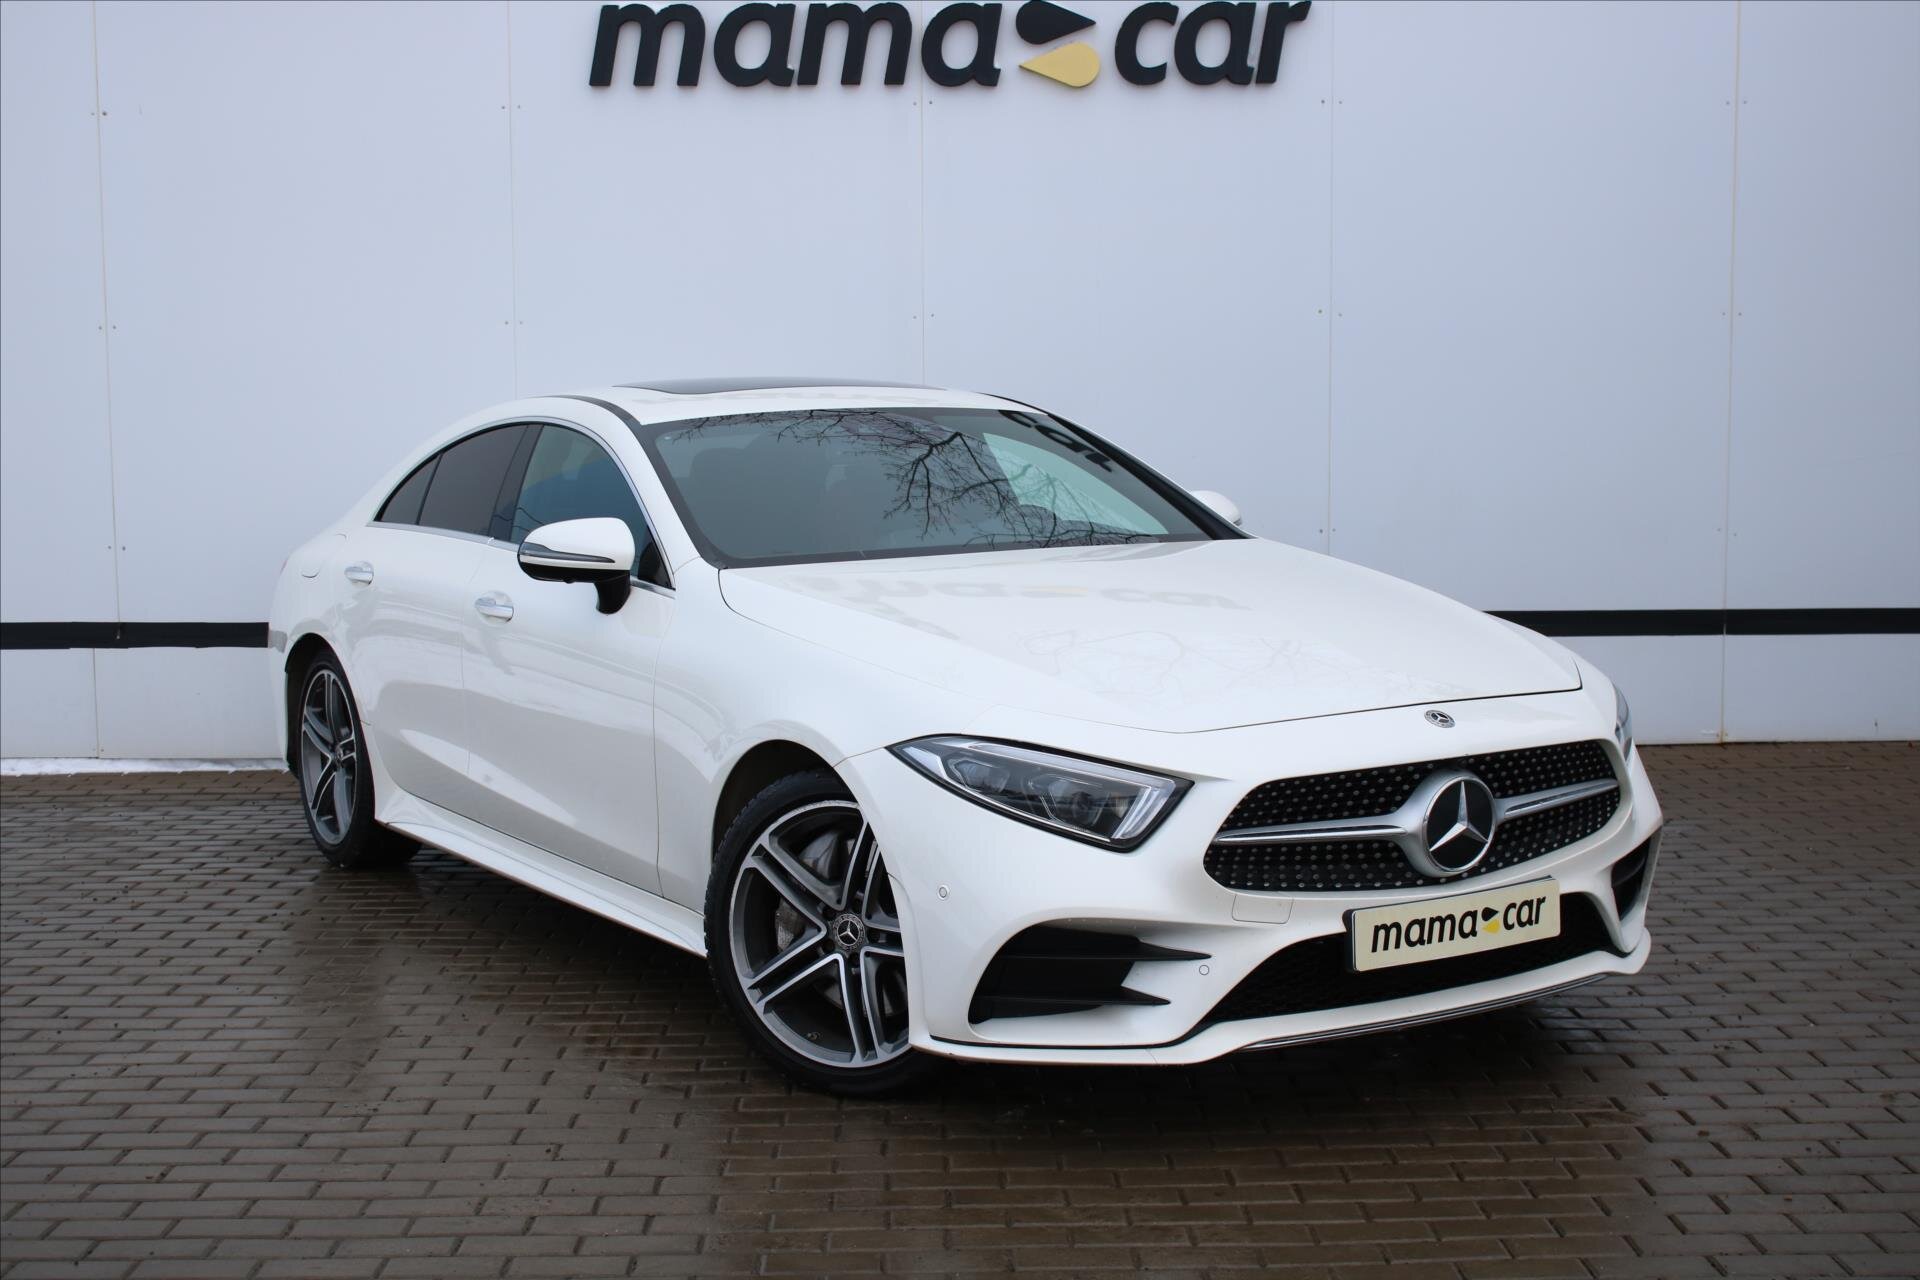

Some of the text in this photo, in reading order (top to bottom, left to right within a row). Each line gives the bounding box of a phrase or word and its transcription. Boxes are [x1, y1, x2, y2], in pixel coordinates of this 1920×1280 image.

[589, 0, 1311, 88] mama car
[1371, 896, 1546, 953] mama car
